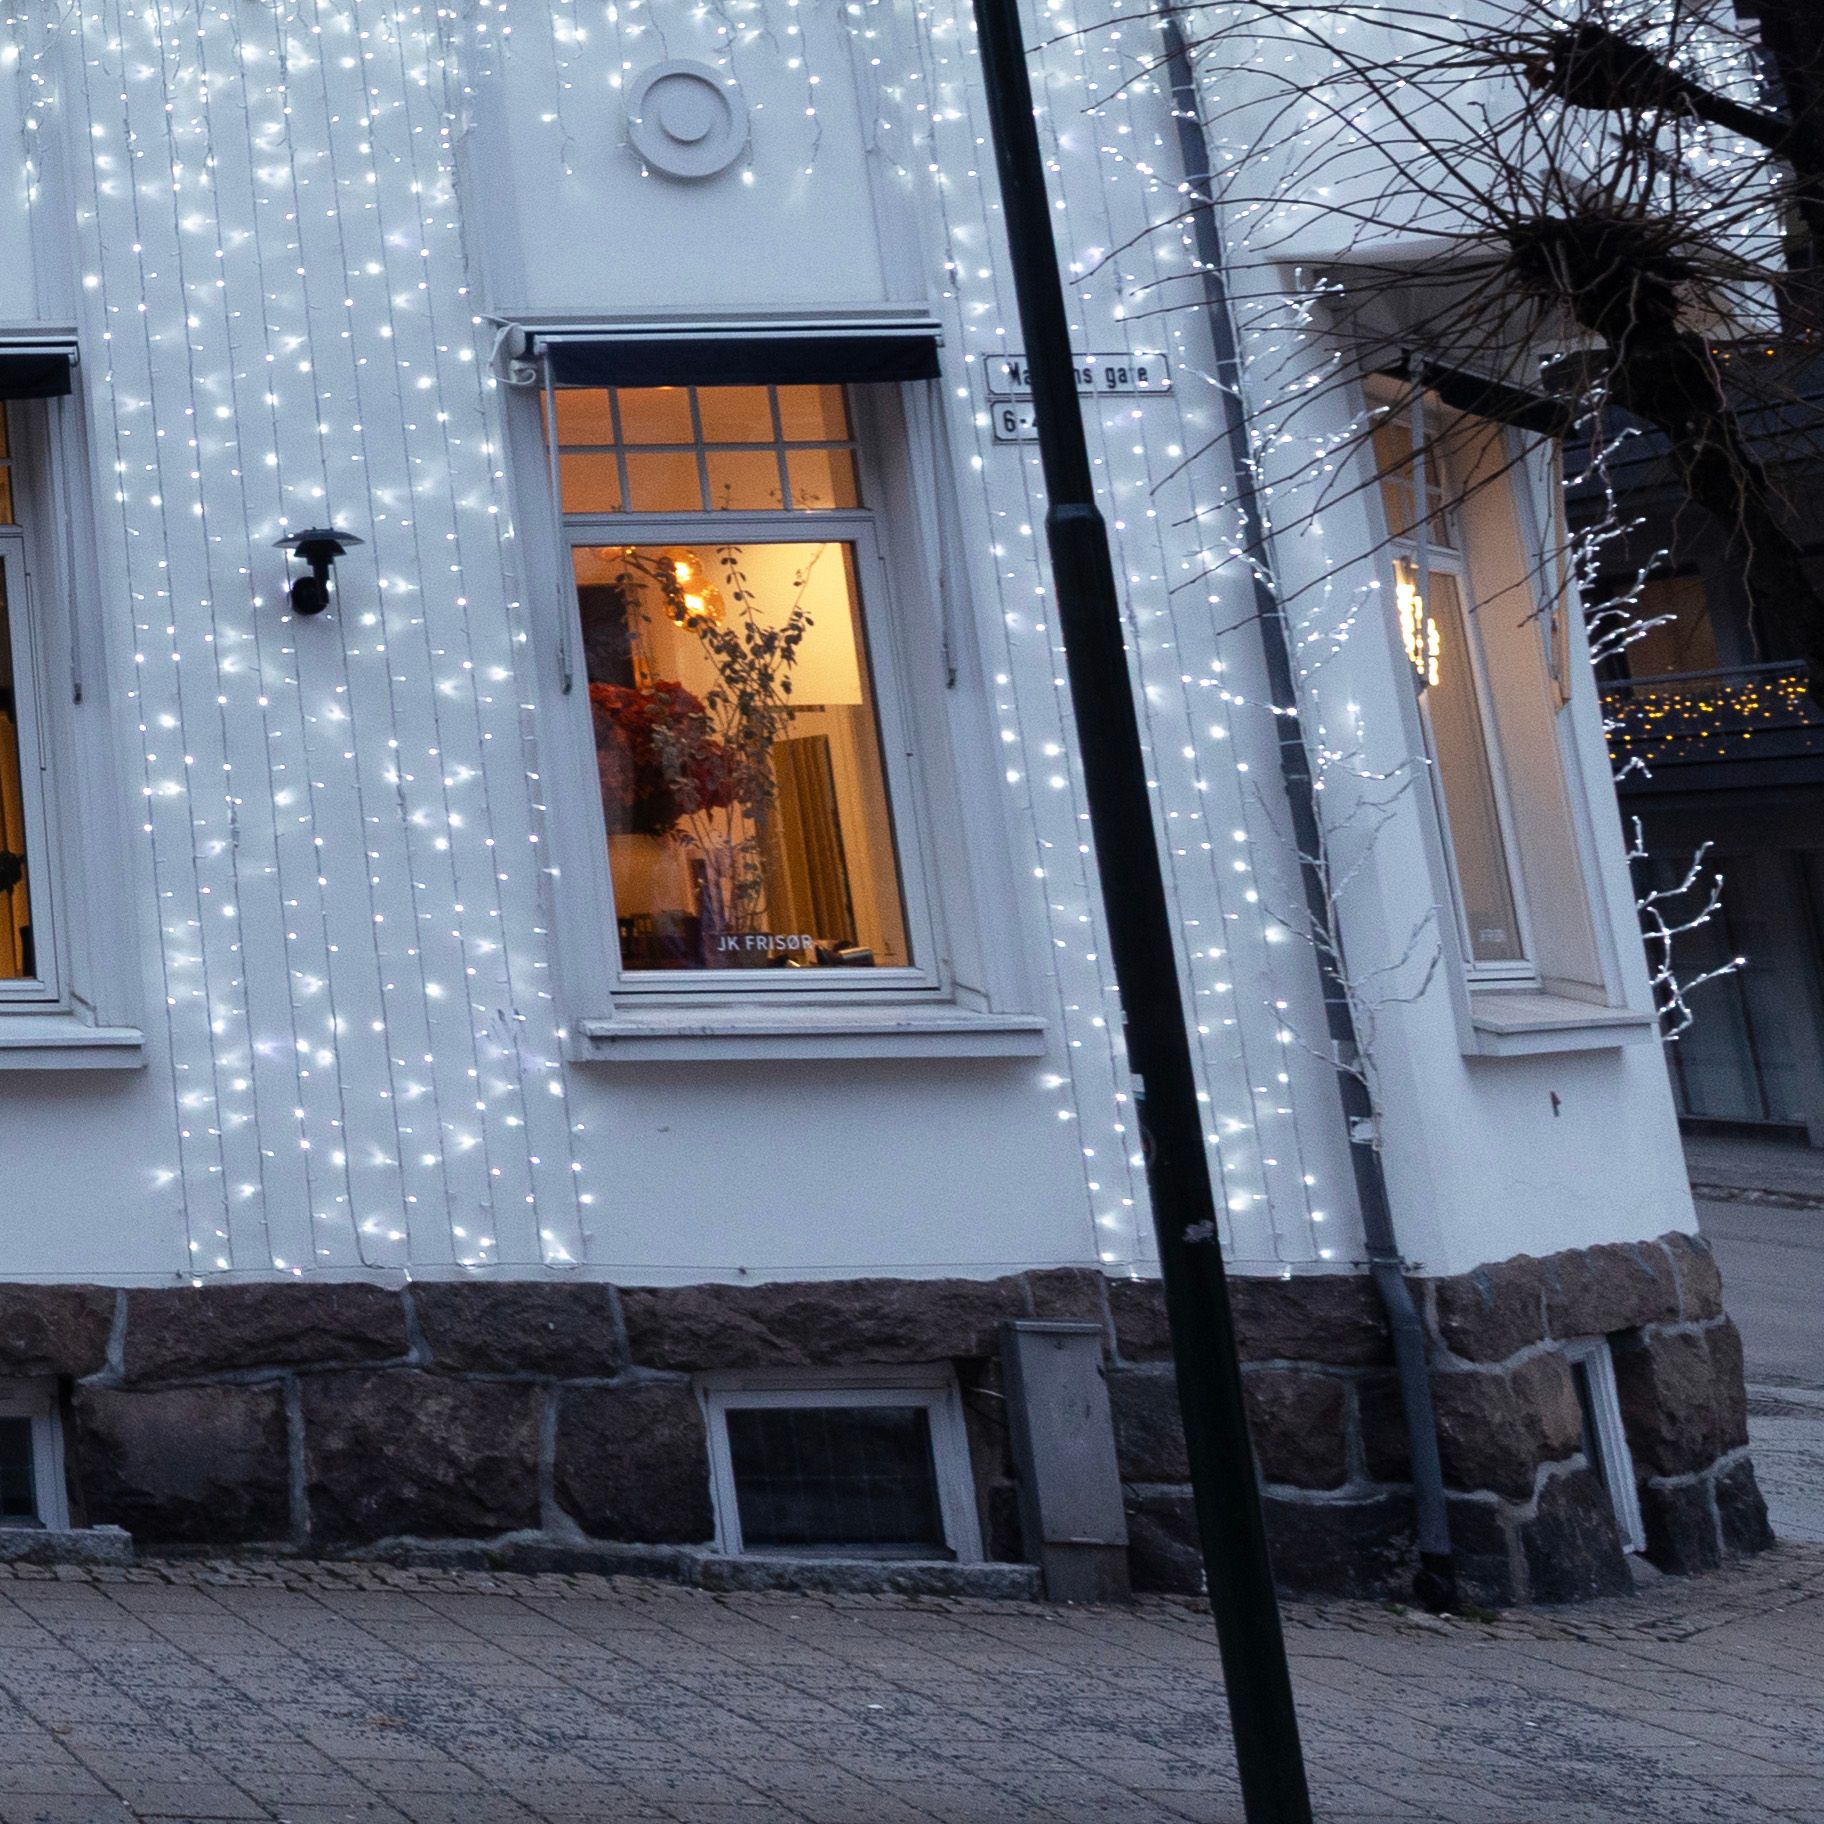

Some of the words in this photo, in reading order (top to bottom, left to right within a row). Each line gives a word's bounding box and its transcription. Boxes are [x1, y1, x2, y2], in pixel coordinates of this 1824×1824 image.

[1006, 362, 1093, 386] Mans
[716, 935, 740, 952] JK
[746, 934, 813, 951] FRISØR
